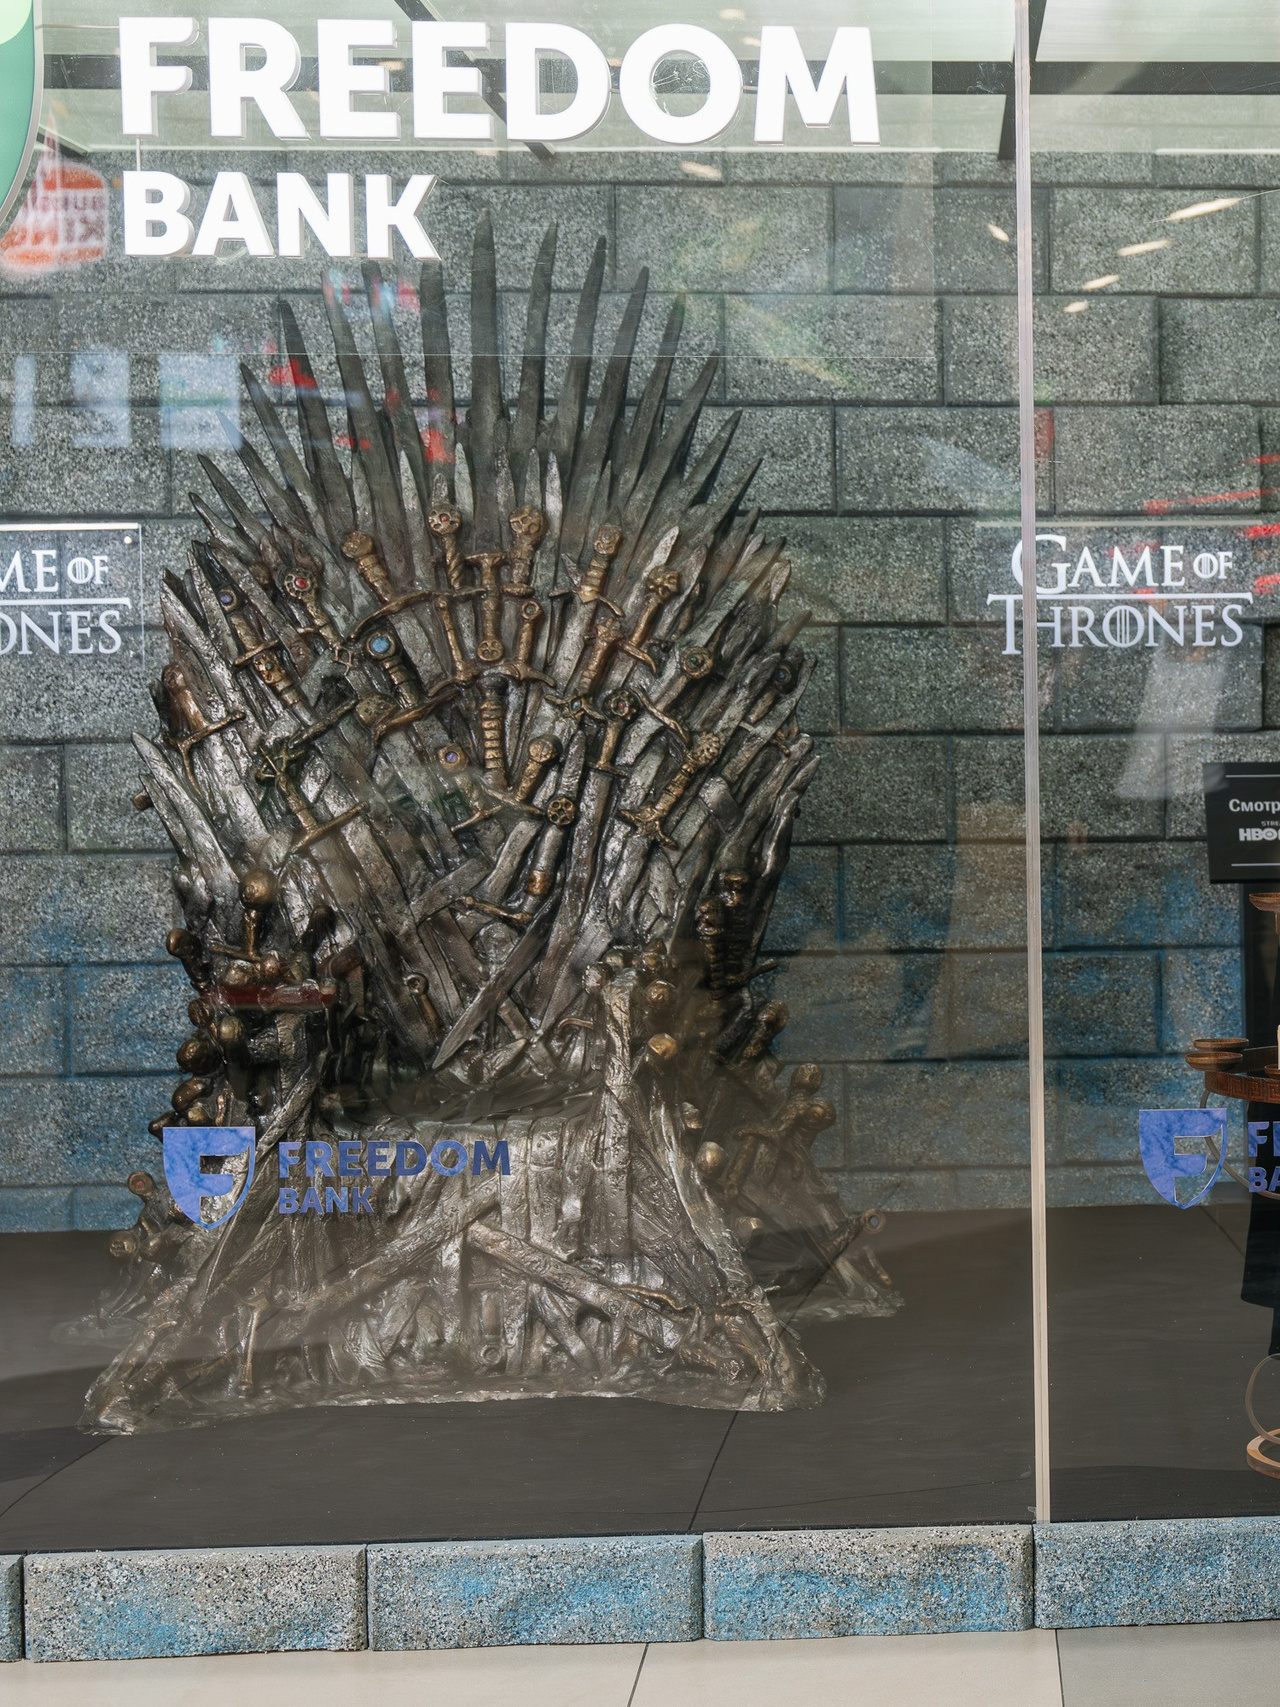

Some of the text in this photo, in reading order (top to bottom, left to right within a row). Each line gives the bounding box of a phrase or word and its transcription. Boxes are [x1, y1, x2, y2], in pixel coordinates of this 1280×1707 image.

[118, 16, 882, 146] FREEDOM
[122, 170, 440, 260] BANK
[66, 554, 109, 585] OF
[1011, 533, 1233, 594] GAME OF
[987, 593, 1246, 655] THRONES
[278, 1139, 511, 1179] FREEDOM
[278, 1187, 374, 1214] BANK
